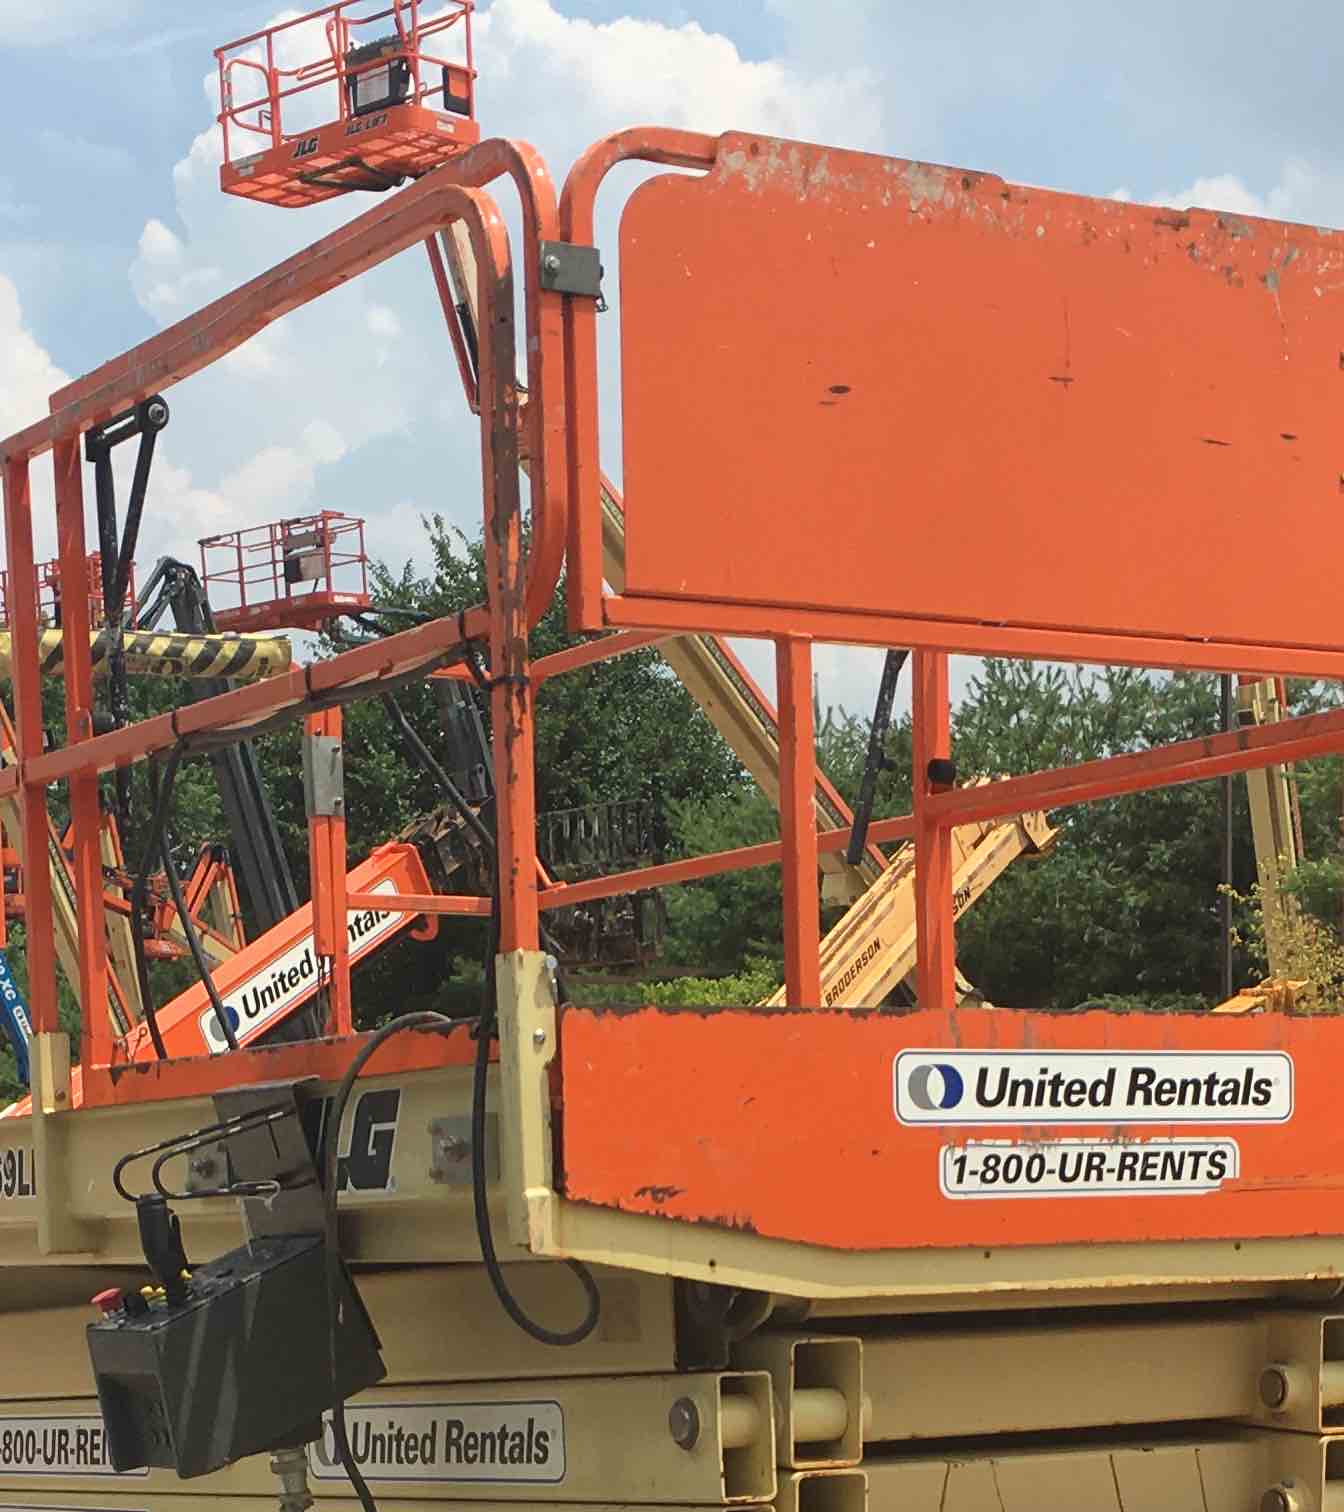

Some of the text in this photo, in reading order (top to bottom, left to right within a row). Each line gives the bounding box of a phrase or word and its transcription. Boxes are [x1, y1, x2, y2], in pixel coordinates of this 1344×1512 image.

[241, 949, 314, 1019] United
[825, 937, 881, 1007] BRODERSON
[976, 1067, 1272, 1107] United Rentals
[952, 1150, 1227, 1186] 1-800-UR-RENTS
[352, 1417, 549, 1465] United Rentals
